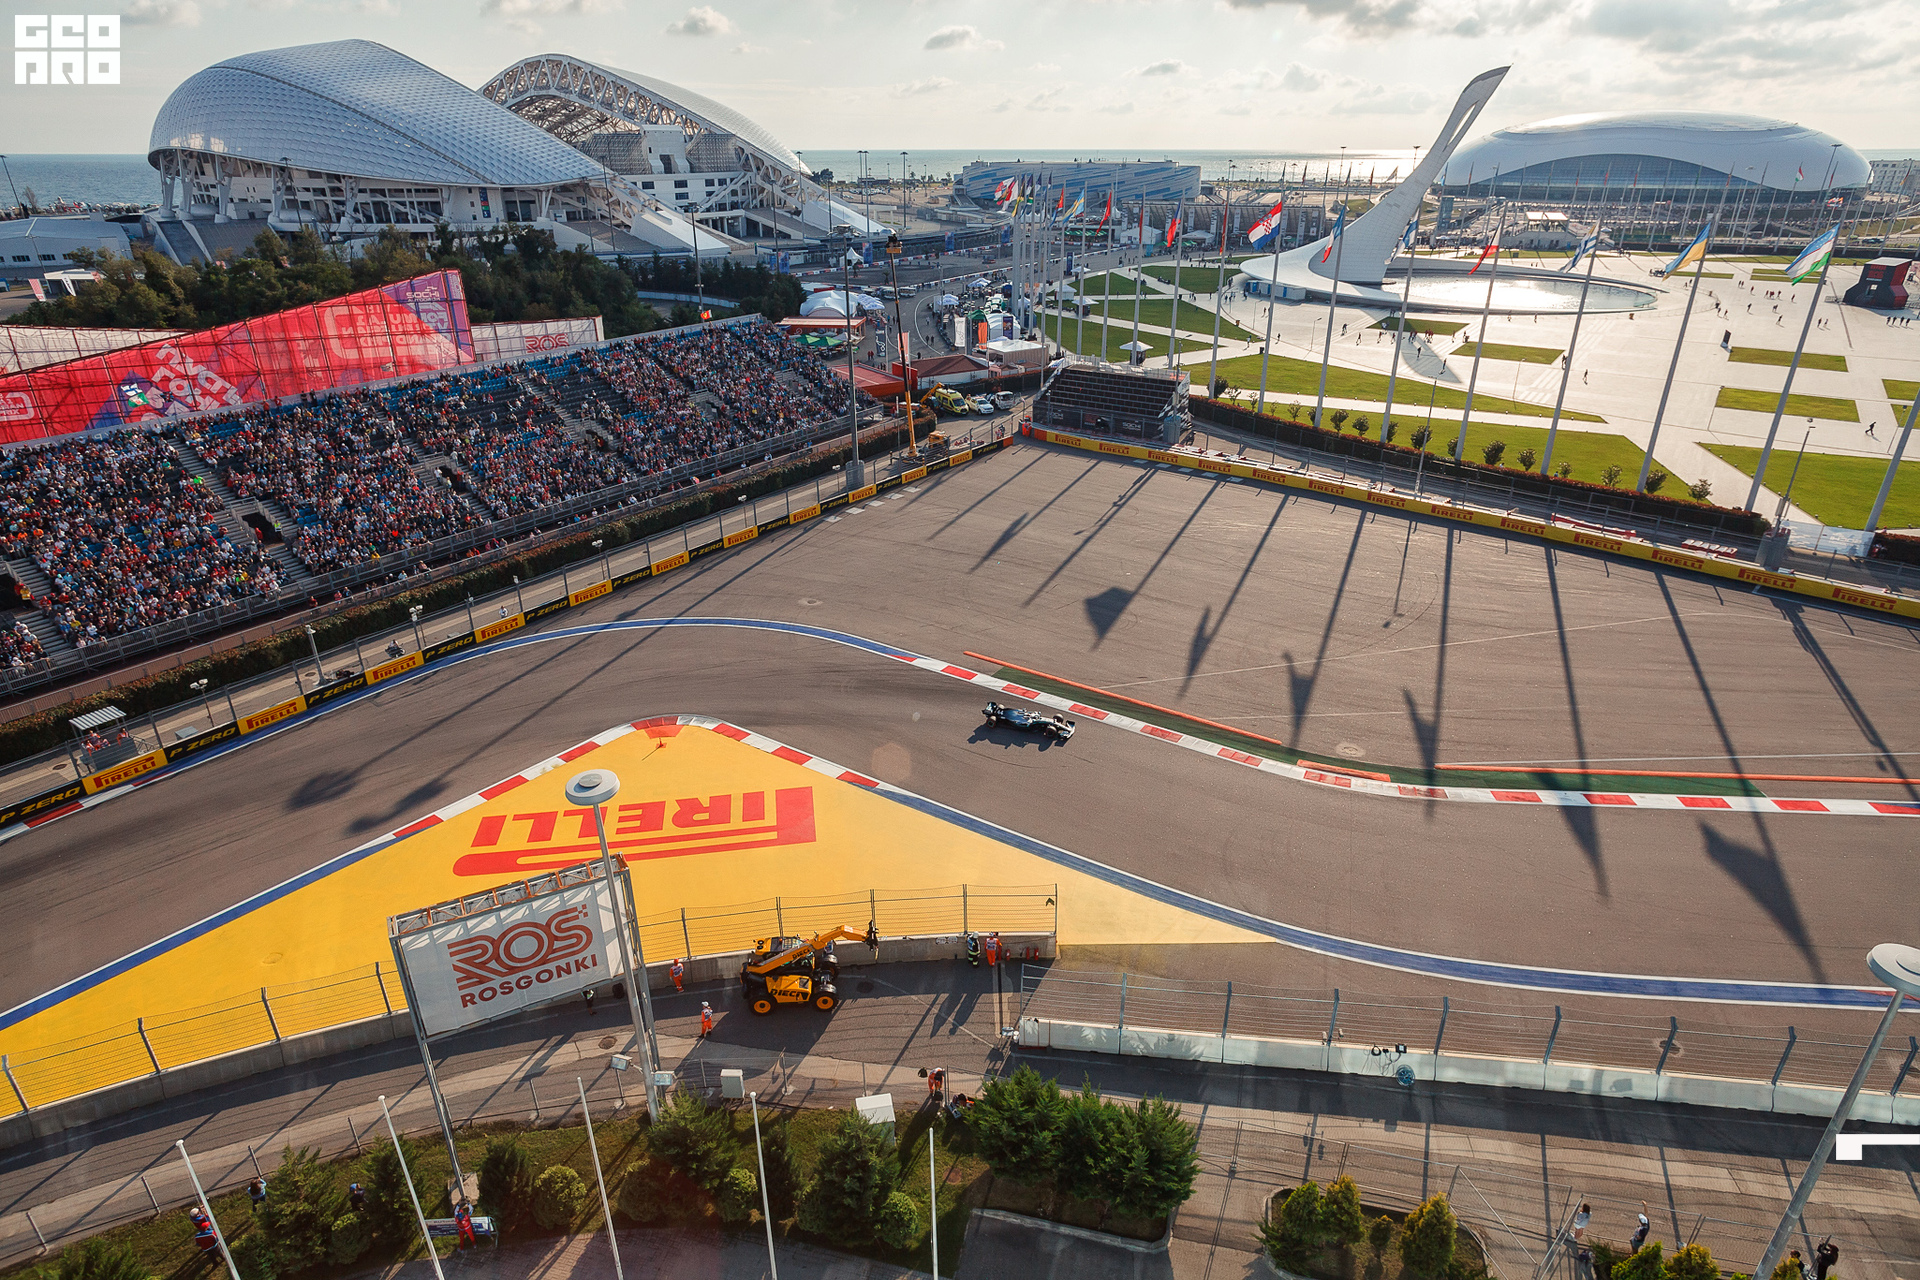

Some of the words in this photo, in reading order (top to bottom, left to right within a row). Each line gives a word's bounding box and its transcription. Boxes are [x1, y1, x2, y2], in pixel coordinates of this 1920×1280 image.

[406, 291, 440, 299] SOCHI
[525, 333, 569, 354] ROS
[1055, 434, 1081, 447] PIRELLI
[1099, 443, 1129, 455] PIRELLI
[1148, 451, 1178, 464] PIRELLI
[1198, 460, 1231, 473] PIRELLI
[904, 469, 924, 482] PIRELLI
[1253, 469, 1286, 483] PIRELLI
[852, 487, 874, 501] PIRELLI
[1309, 480, 1345, 495] PIRELLI
[828, 497, 848, 508] ZERO
[1367, 493, 1406, 507] PIRELLI
[793, 506, 817, 522] PIRELLI
[1431, 505, 1474, 521] PIRELLI
[767, 518, 788, 529] ZERO
[1500, 518, 1545, 535] PIRELLI
[727, 528, 754, 546] PIRELLI
[1574, 533, 1623, 552] PIRELLI
[700, 541, 723, 555] ZERO
[655, 555, 685, 573] PIRELLI
[1651, 549, 1704, 570] PIRELLI
[623, 569, 650, 583] ZERO
[1738, 568, 1796, 589] PIRELLI
[574, 584, 607, 604] PIRELLI
[1832, 587, 1897, 611] PIRELLI
[526, 613, 535, 621] P
[537, 600, 568, 617] ZERO
[481, 618, 519, 639] PIRELLI
[425, 651, 435, 659] P
[437, 636, 474, 655] ZERO
[373, 656, 417, 681] PIRELLI
[309, 695, 320, 705] P
[323, 678, 364, 700] ZERO
[246, 701, 297, 730] PIRELLI
[169, 747, 182, 759] P
[186, 727, 236, 752] ZERO
[93, 755, 156, 789] PIRELLI
[0, 812, 15, 824] P
[21, 786, 81, 815] ZERO
[453, 786, 816, 877] PIRELLI
[447, 903, 593, 991] ROS
[460, 953, 597, 1009] ROSGONKI
[770, 988, 800, 998] DIECI
